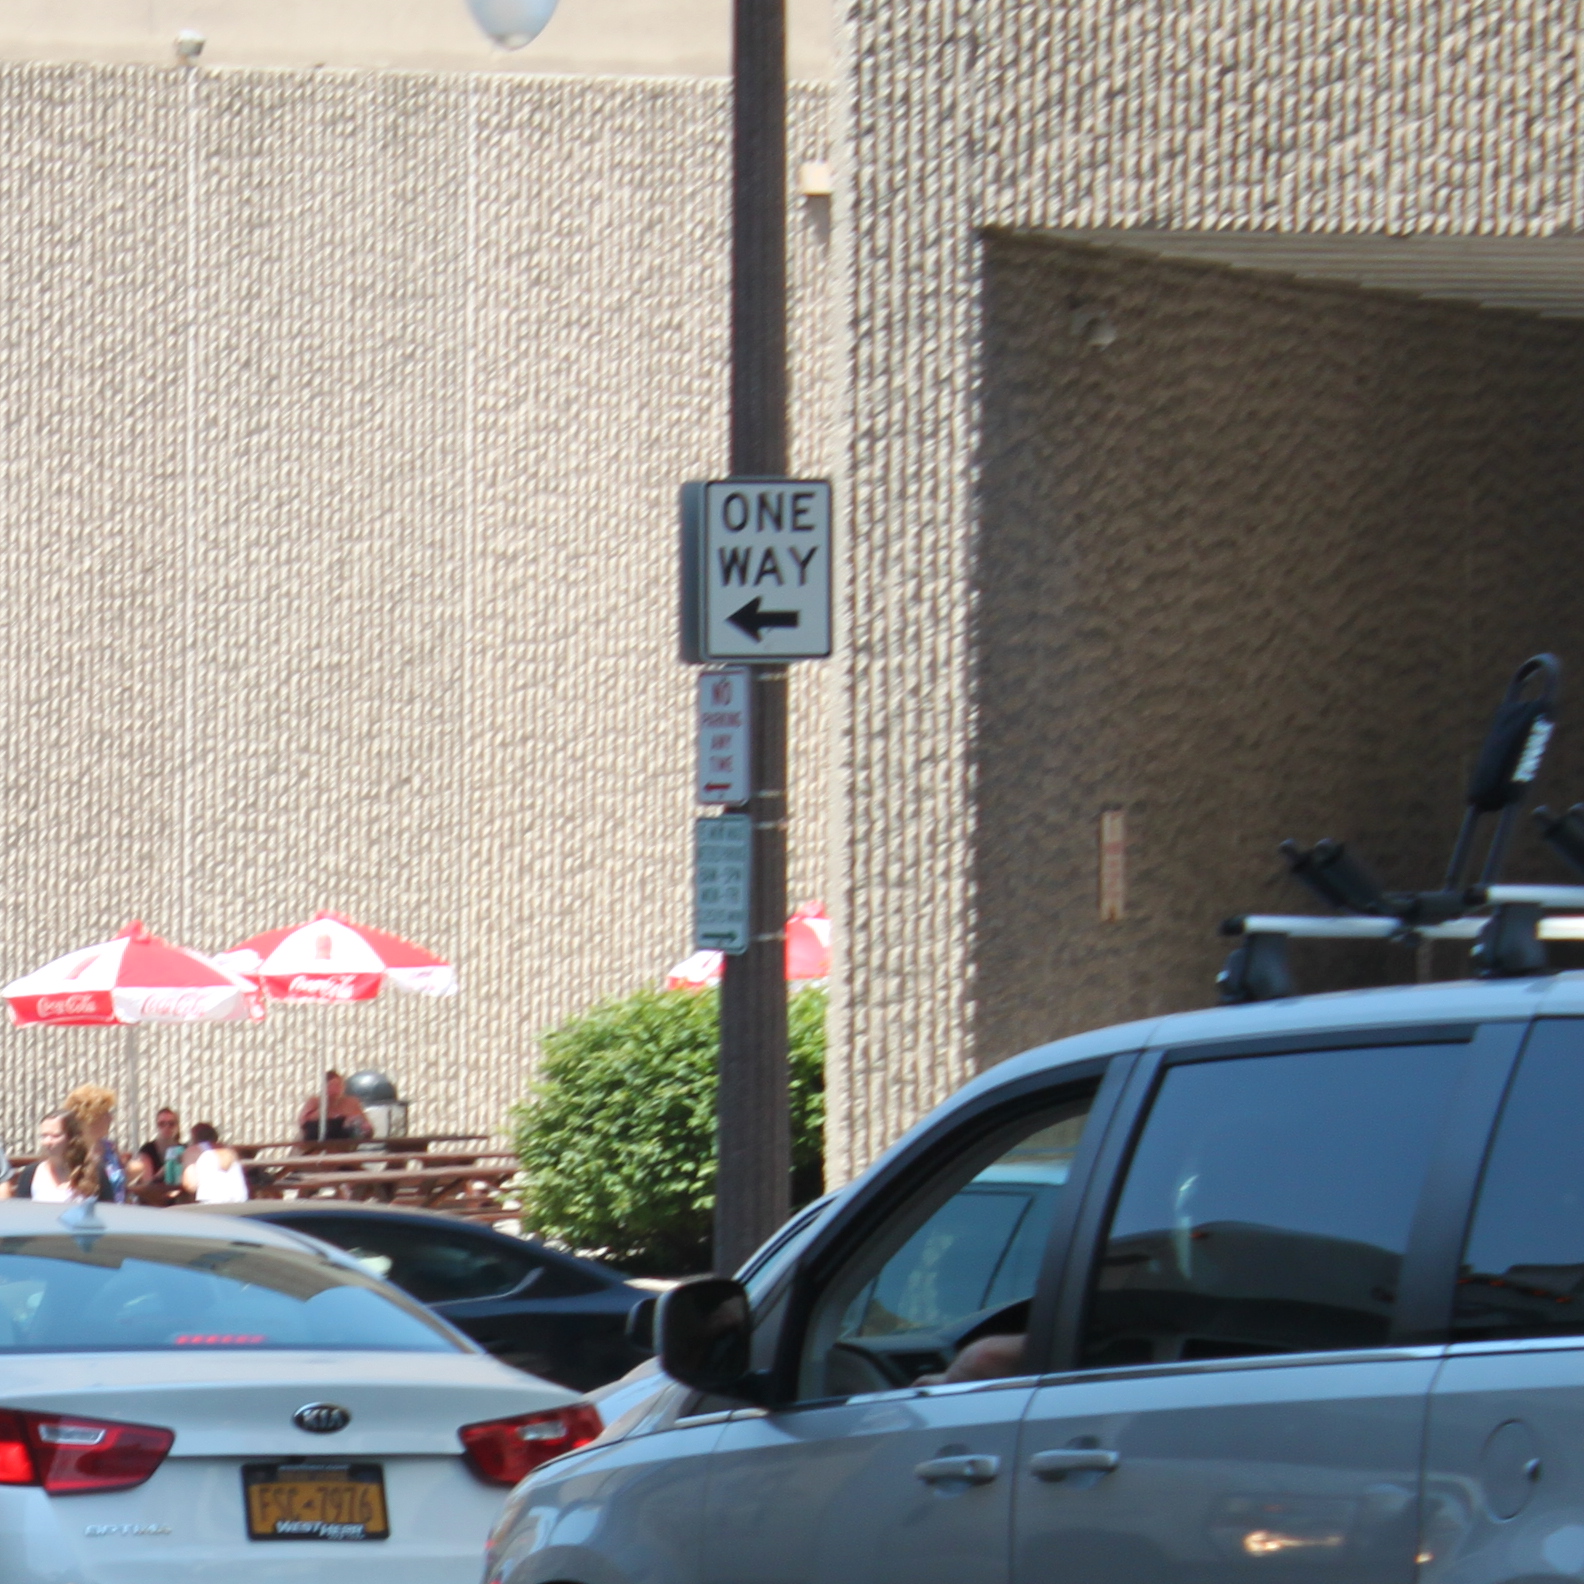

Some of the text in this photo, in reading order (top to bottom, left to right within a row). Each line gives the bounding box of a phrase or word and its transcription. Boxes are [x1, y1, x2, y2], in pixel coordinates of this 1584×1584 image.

[721, 491, 817, 533] ONE
[717, 546, 820, 588] WAY
[37, 994, 97, 1018] Coca-Cola
